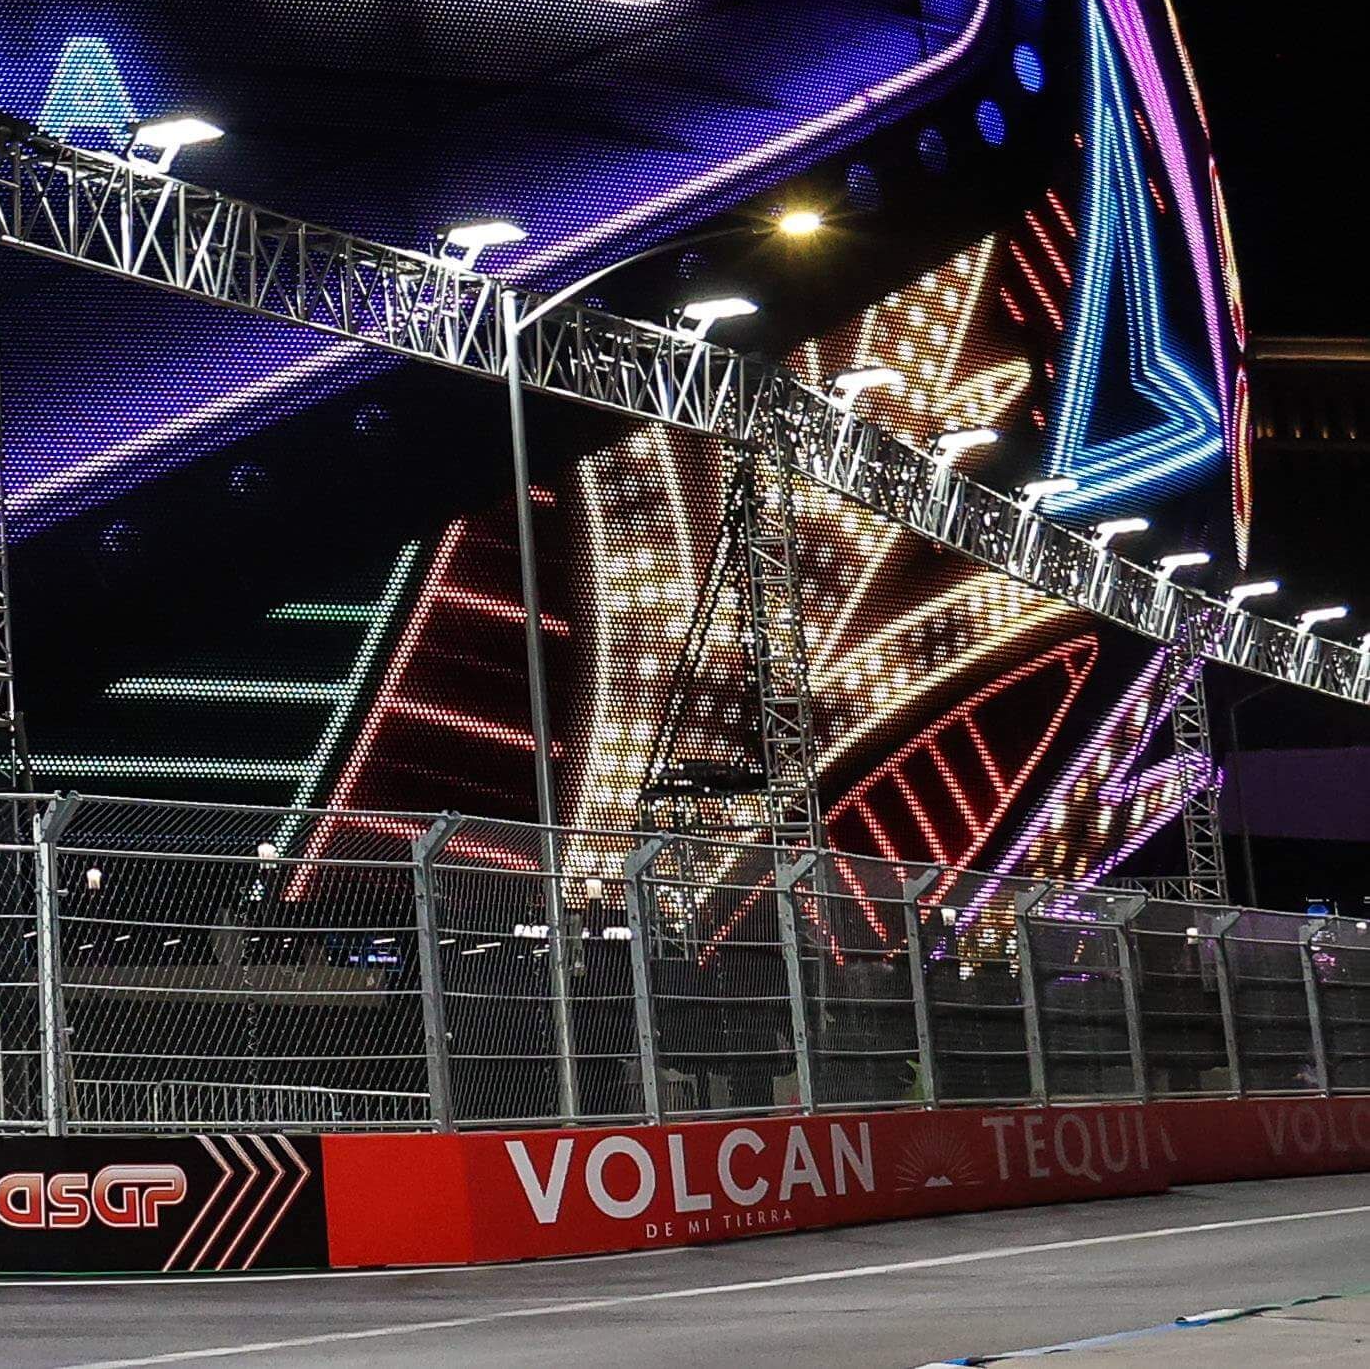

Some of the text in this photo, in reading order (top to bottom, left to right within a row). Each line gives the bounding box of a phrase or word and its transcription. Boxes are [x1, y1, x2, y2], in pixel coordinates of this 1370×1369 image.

[504, 1121, 874, 1224] VOLCAN
[646, 1209, 793, 1238] DE MI TIERRA
